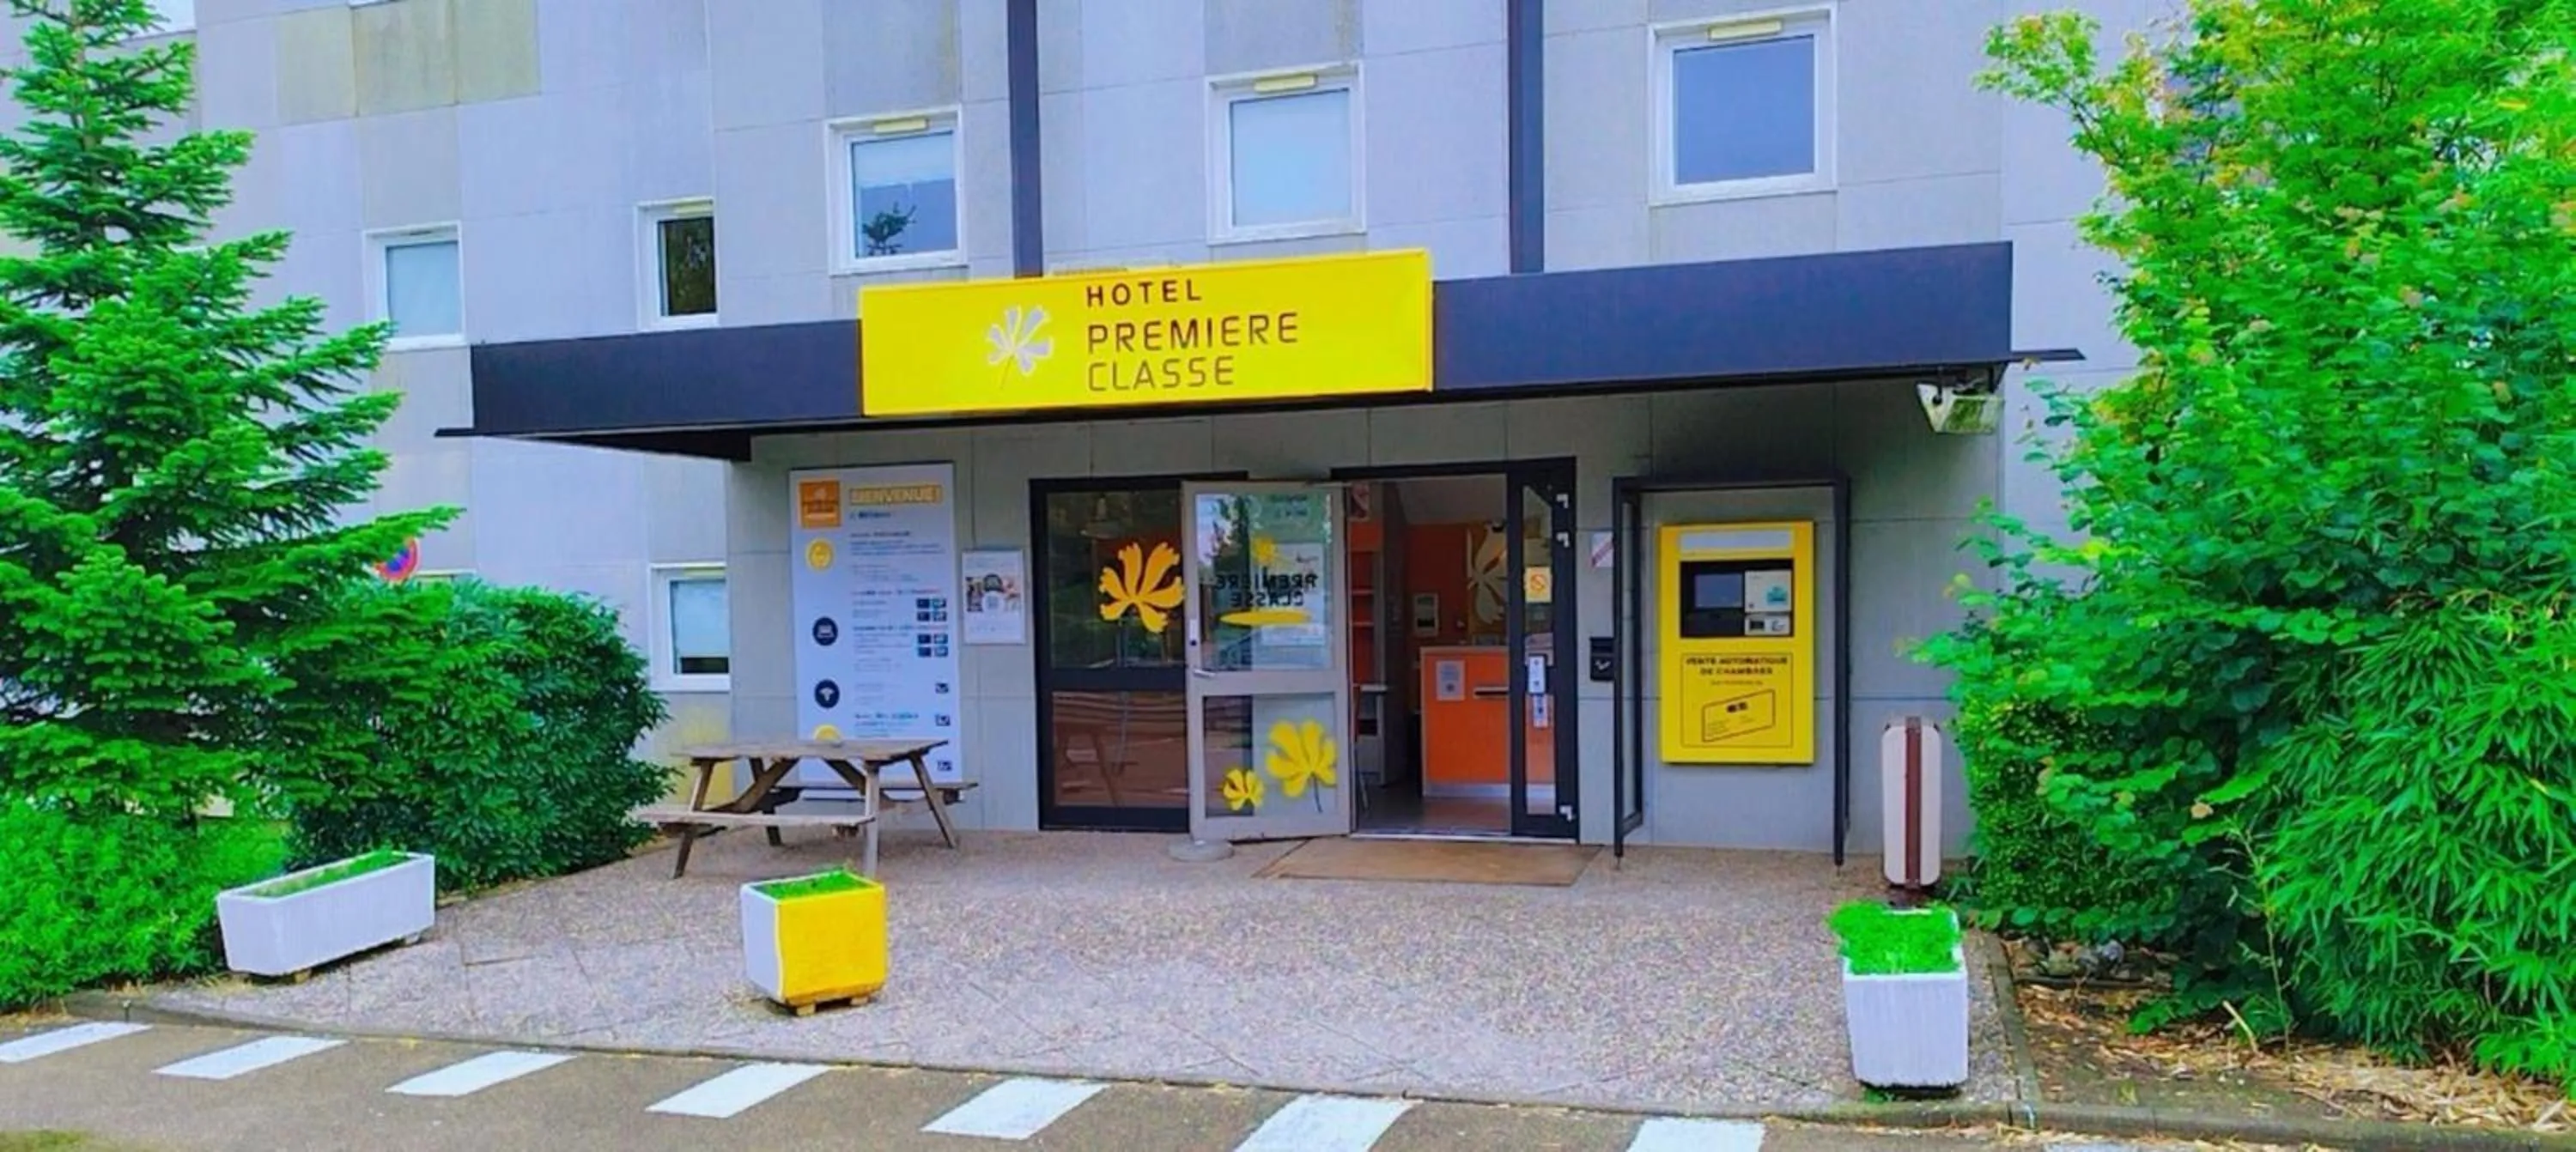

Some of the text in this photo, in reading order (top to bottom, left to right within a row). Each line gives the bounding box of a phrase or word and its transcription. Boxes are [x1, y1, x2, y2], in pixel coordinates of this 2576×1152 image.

[1085, 279, 1202, 307] HOTEL
[1087, 312, 1298, 355] PREMIERE
[1088, 355, 1235, 391] CLASSE
